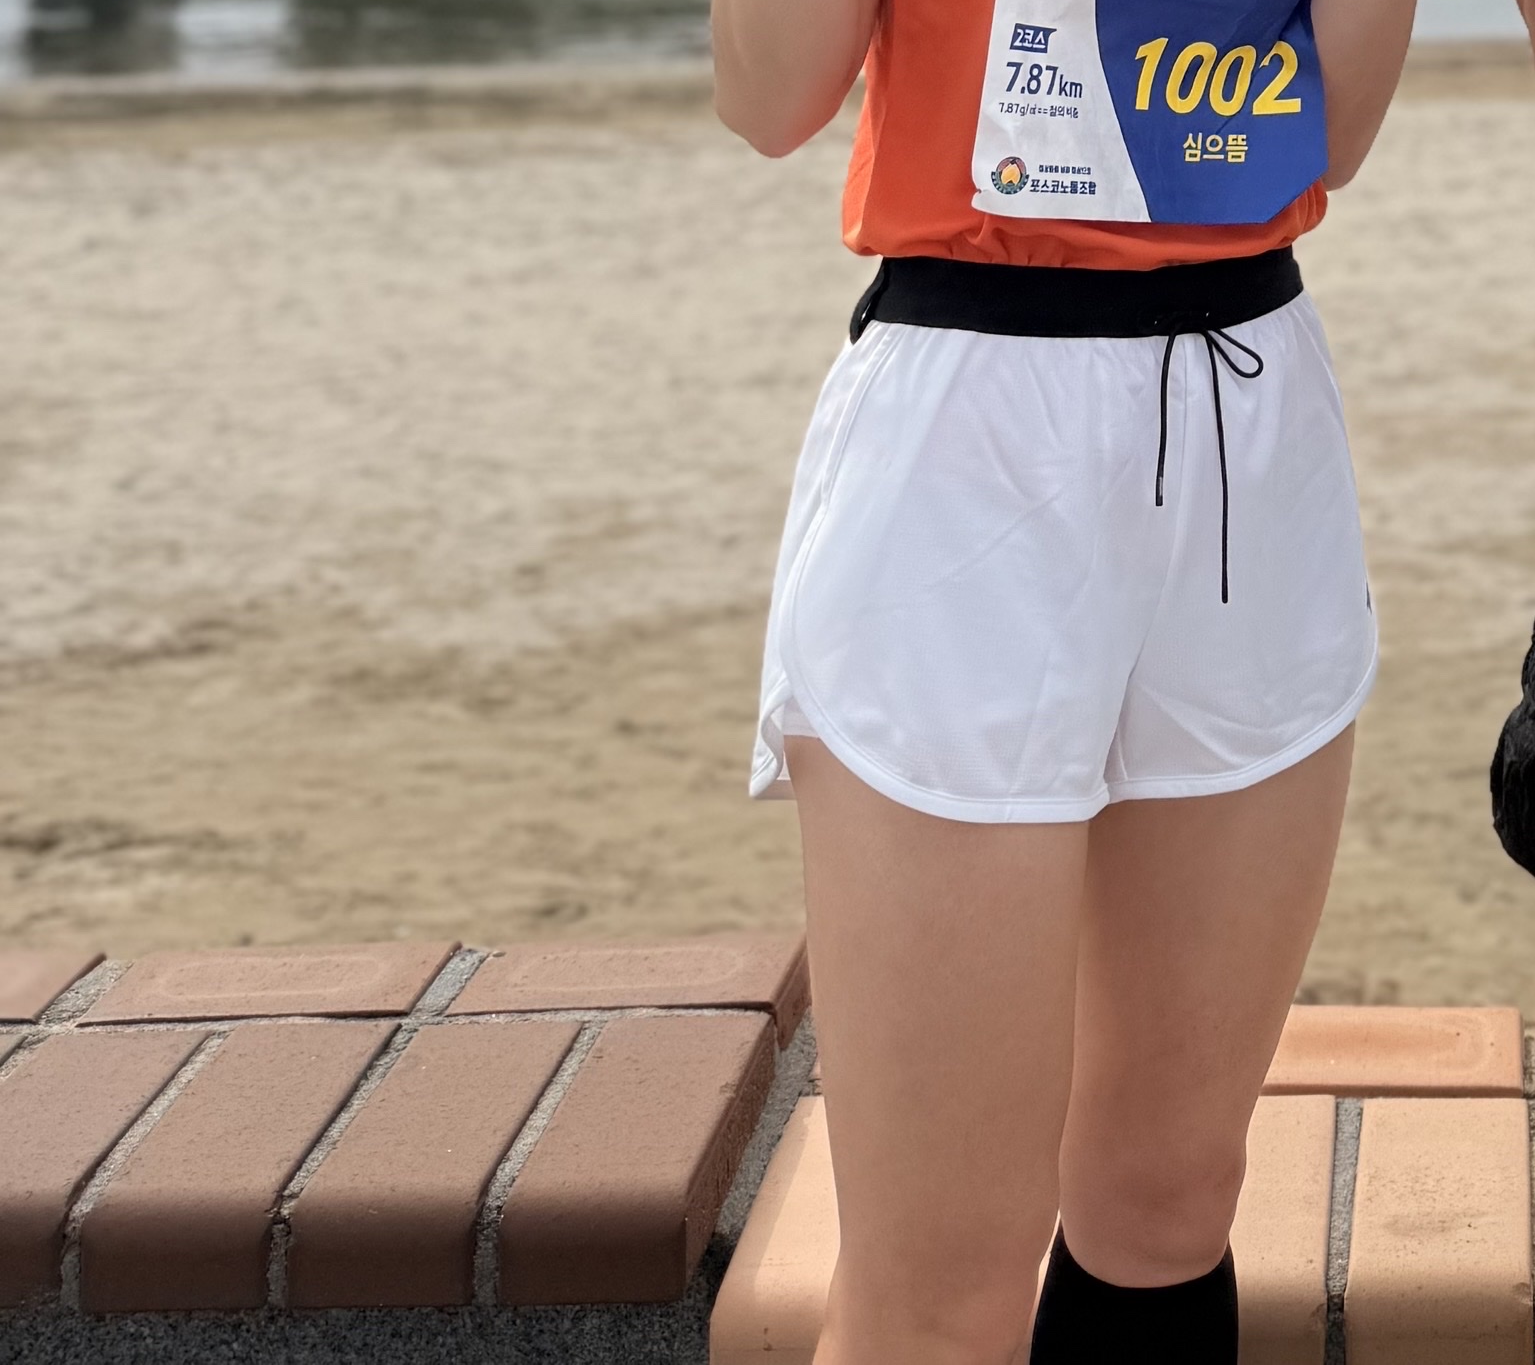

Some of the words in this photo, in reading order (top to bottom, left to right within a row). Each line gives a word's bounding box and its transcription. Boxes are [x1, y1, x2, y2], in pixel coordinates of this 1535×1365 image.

[1013, 28, 1046, 49] 2코스
[1135, 37, 1301, 116] 1002
[1183, 132, 1248, 163] 심으뜸
[1030, 179, 1097, 195] 포스코노동조합
